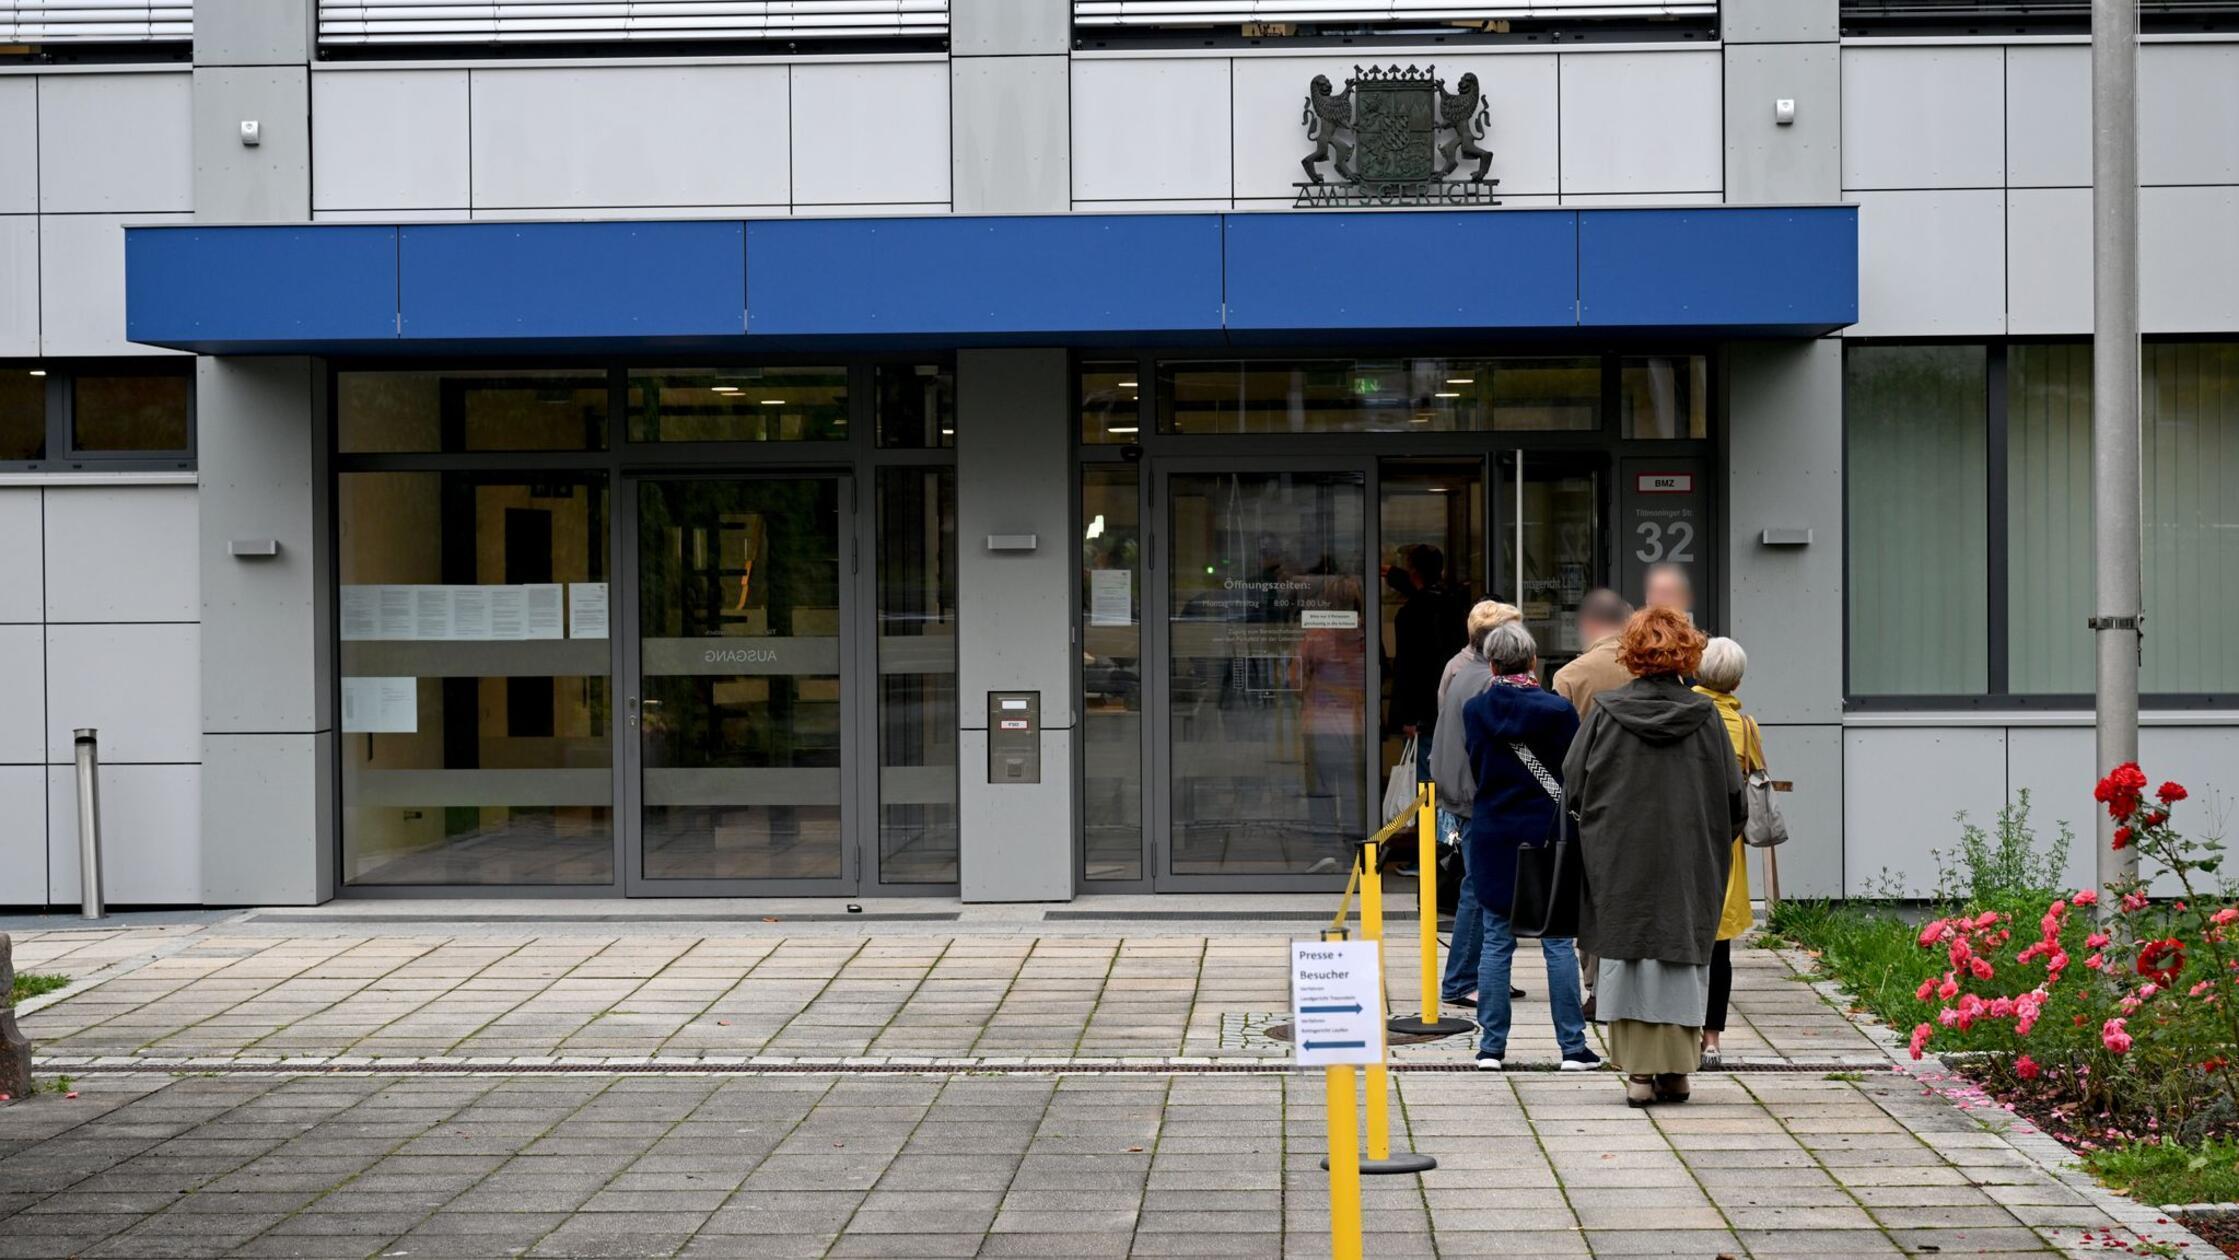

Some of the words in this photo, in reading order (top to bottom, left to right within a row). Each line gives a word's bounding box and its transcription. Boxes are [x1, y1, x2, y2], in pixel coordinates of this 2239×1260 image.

[1654, 479, 1675, 488] BMZ
[1636, 521, 1694, 563] 32
[1223, 578, 1311, 592] Öffnungszeiten:
[1299, 950, 1334, 960] Presse
[1299, 970, 1349, 980] Besucher
